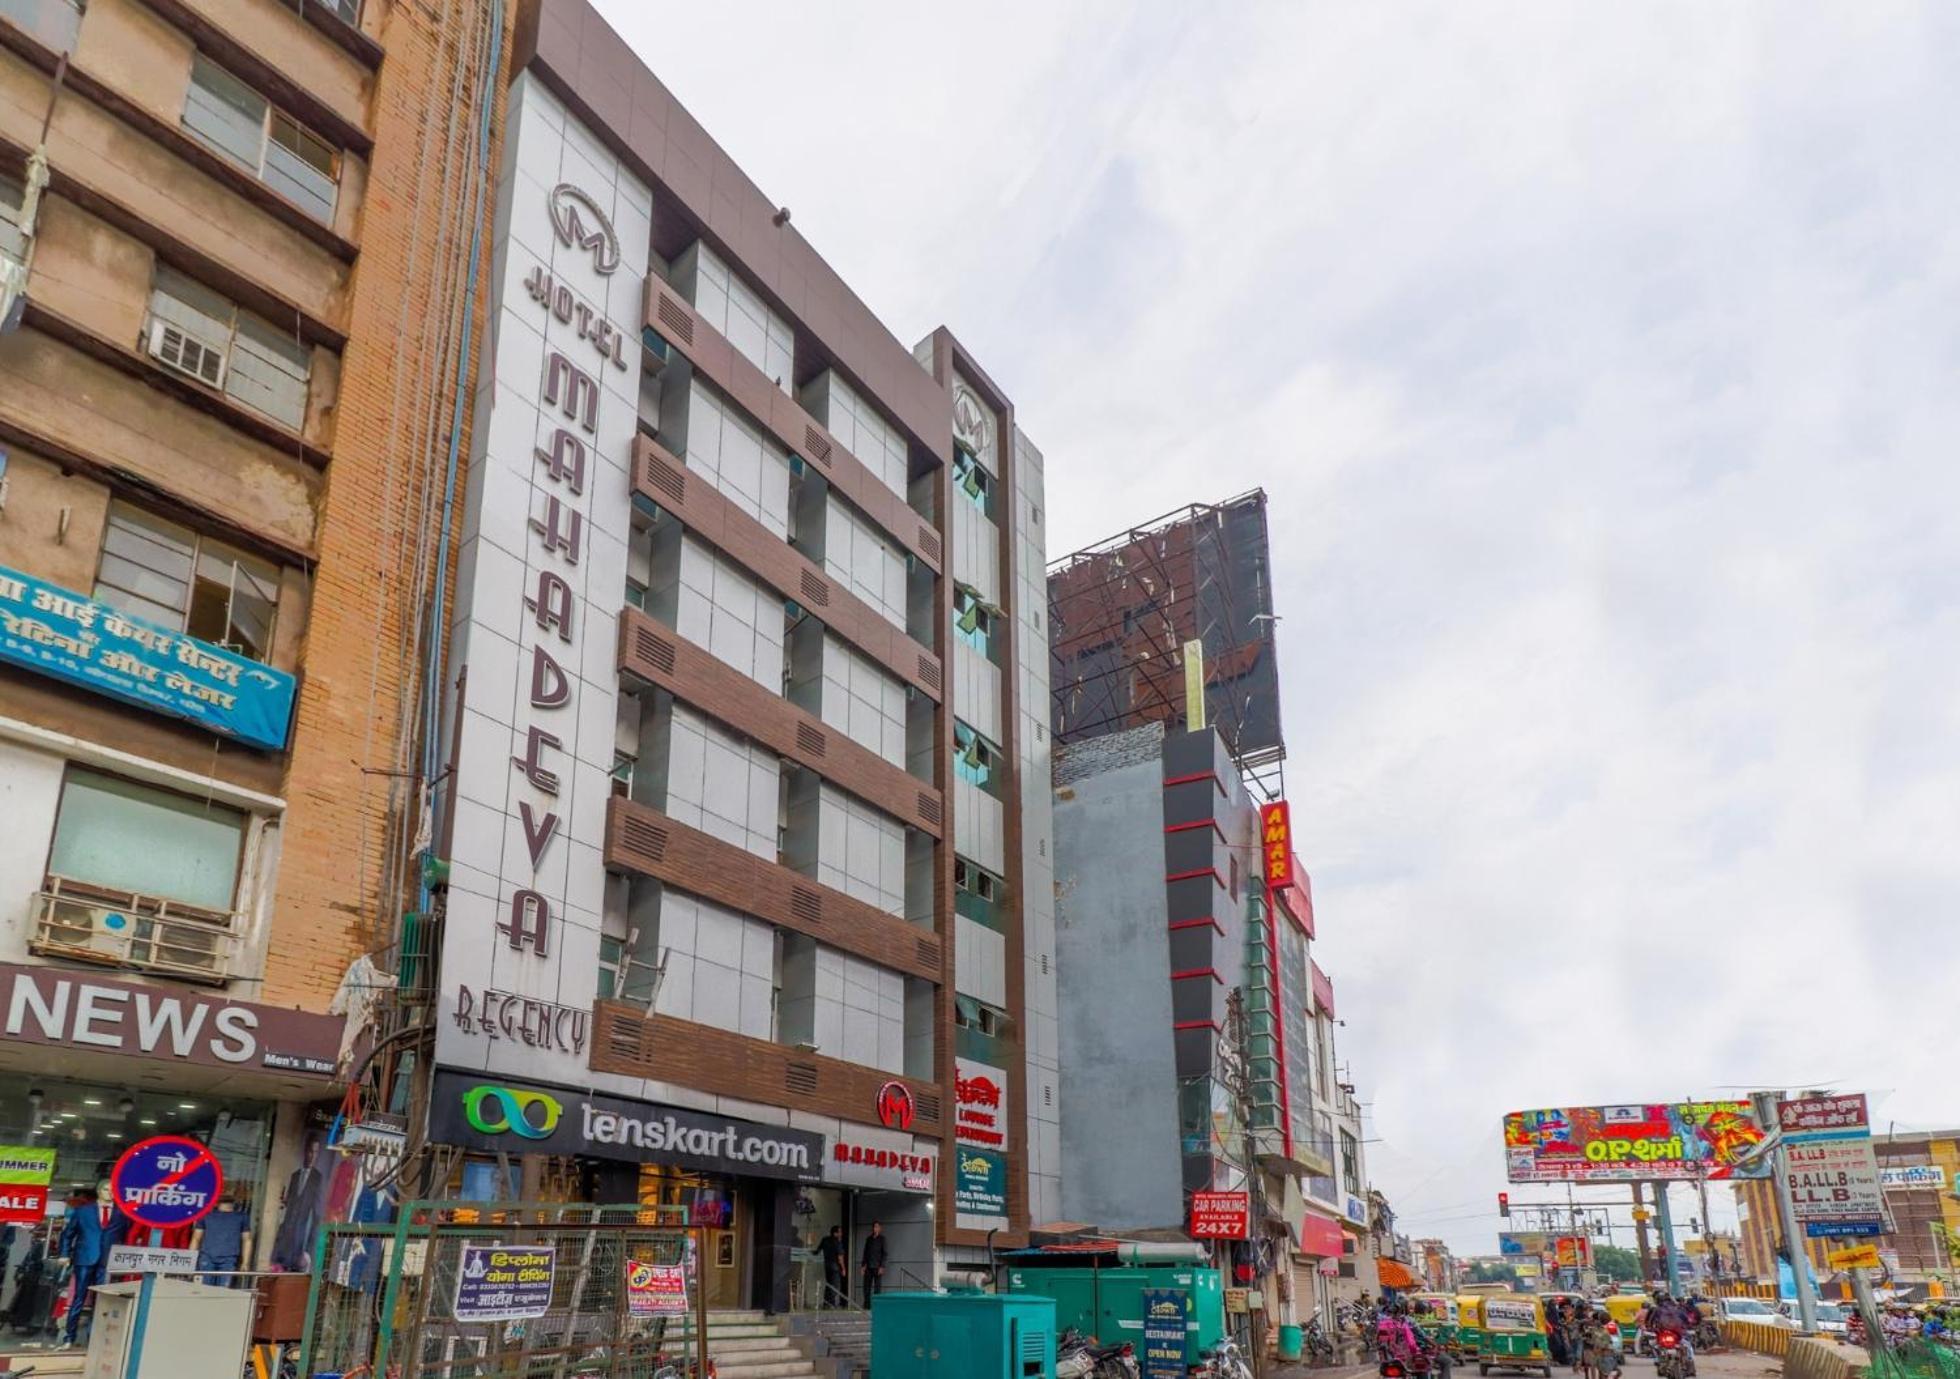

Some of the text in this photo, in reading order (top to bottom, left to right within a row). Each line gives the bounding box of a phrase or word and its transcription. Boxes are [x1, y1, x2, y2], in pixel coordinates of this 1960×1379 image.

[524, 266, 627, 371] HOTEL
[100, 649, 160, 684] और
[497, 352, 598, 957] MAHADEVA
[1265, 808, 1287, 879] AMAR
[6, 973, 259, 1063] NEWS
[453, 984, 586, 1056] REGENCY
[264, 1052, 335, 1073] Men's Wear
[581, 1101, 809, 1170] lenskart.com
[156, 1150, 187, 1173] नो
[834, 1143, 931, 1174] MAHADEVA
[1896, 1166, 1942, 1183] पार्किंग
[123, 1183, 209, 1209] पार्किंग
[1193, 1199, 1246, 1213] CAR PARKING
[1791, 1188, 1850, 1203] LL.B
[1195, 1222, 1242, 1234] 24X7
[113, 1249, 193, 1271] कानपुर नगर निगम
[490, 1252, 550, 1266] डिप्लोमा
[486, 1267, 550, 1282] योगा टीचिंग
